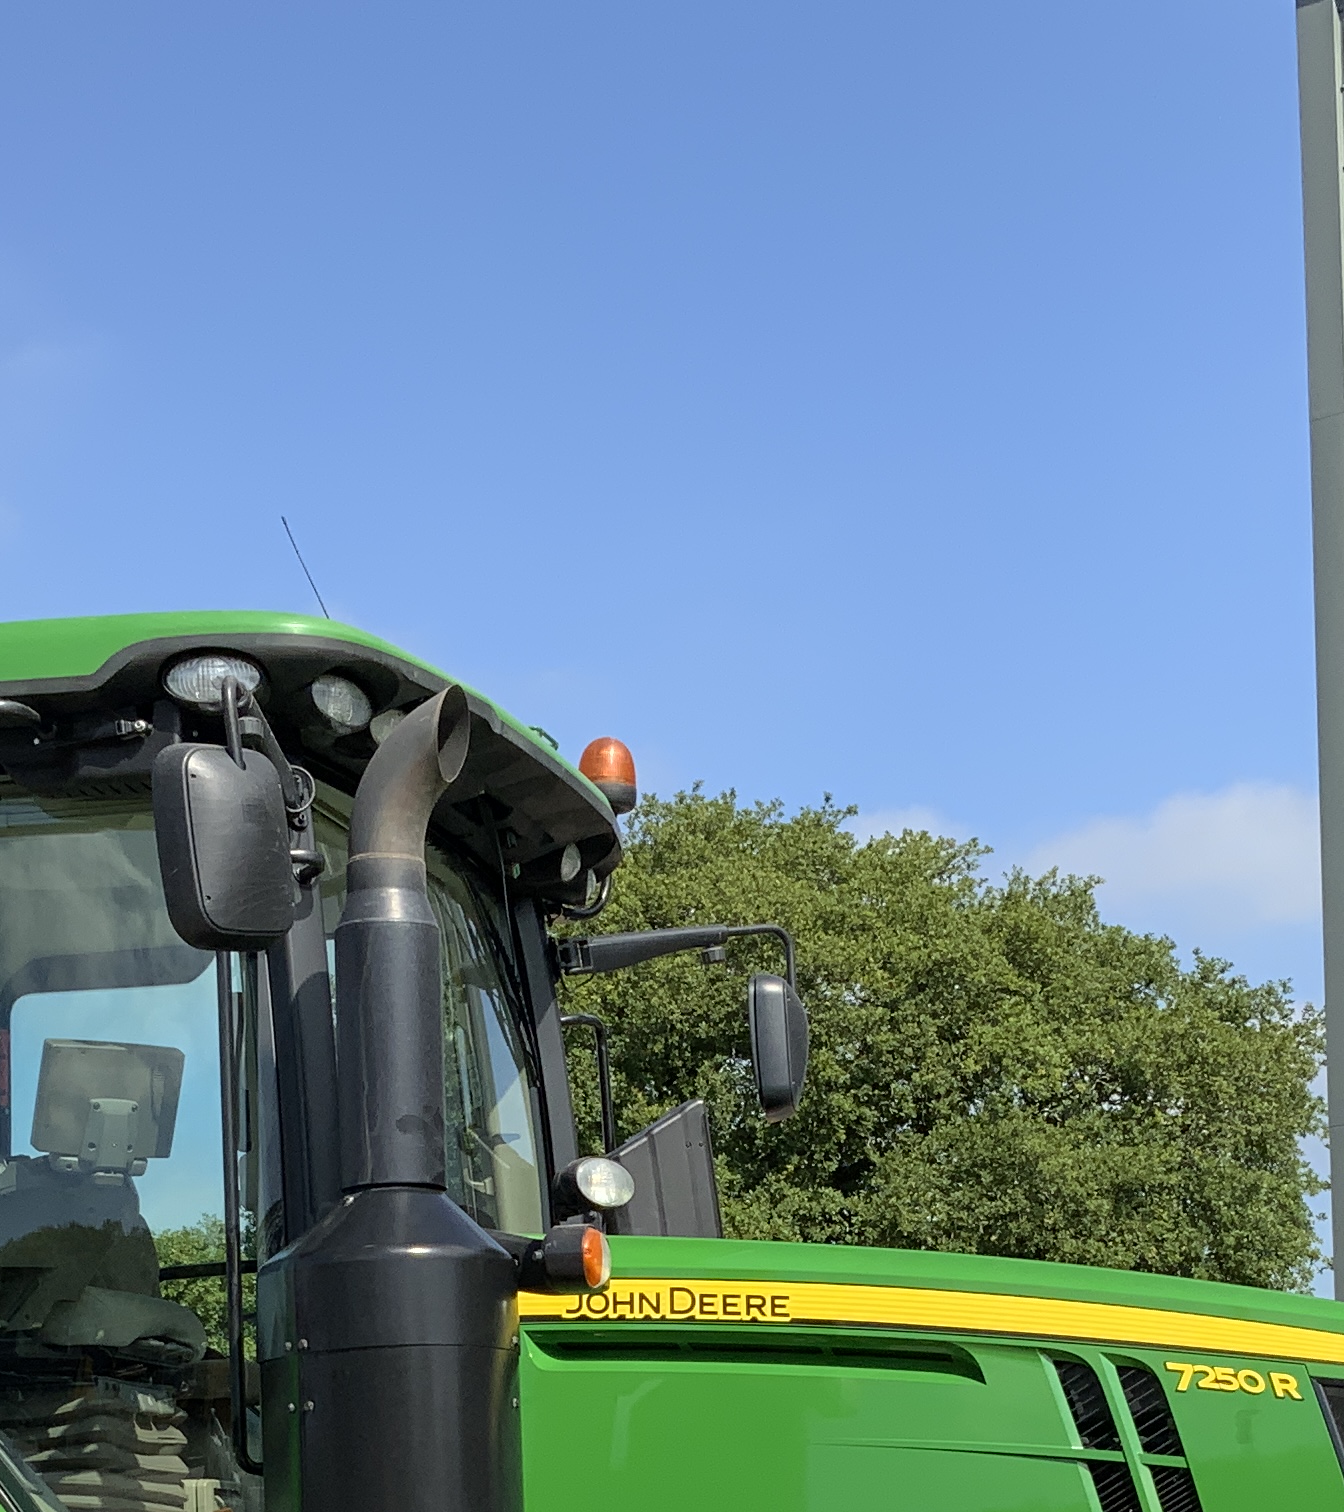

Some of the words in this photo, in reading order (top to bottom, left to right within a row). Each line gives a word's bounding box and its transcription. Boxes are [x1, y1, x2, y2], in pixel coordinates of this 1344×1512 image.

[566, 1292, 660, 1315] JOHN
[670, 1287, 790, 1317] DEERE
[1164, 1361, 1267, 1394] 7250
[1268, 1371, 1304, 1401] R
